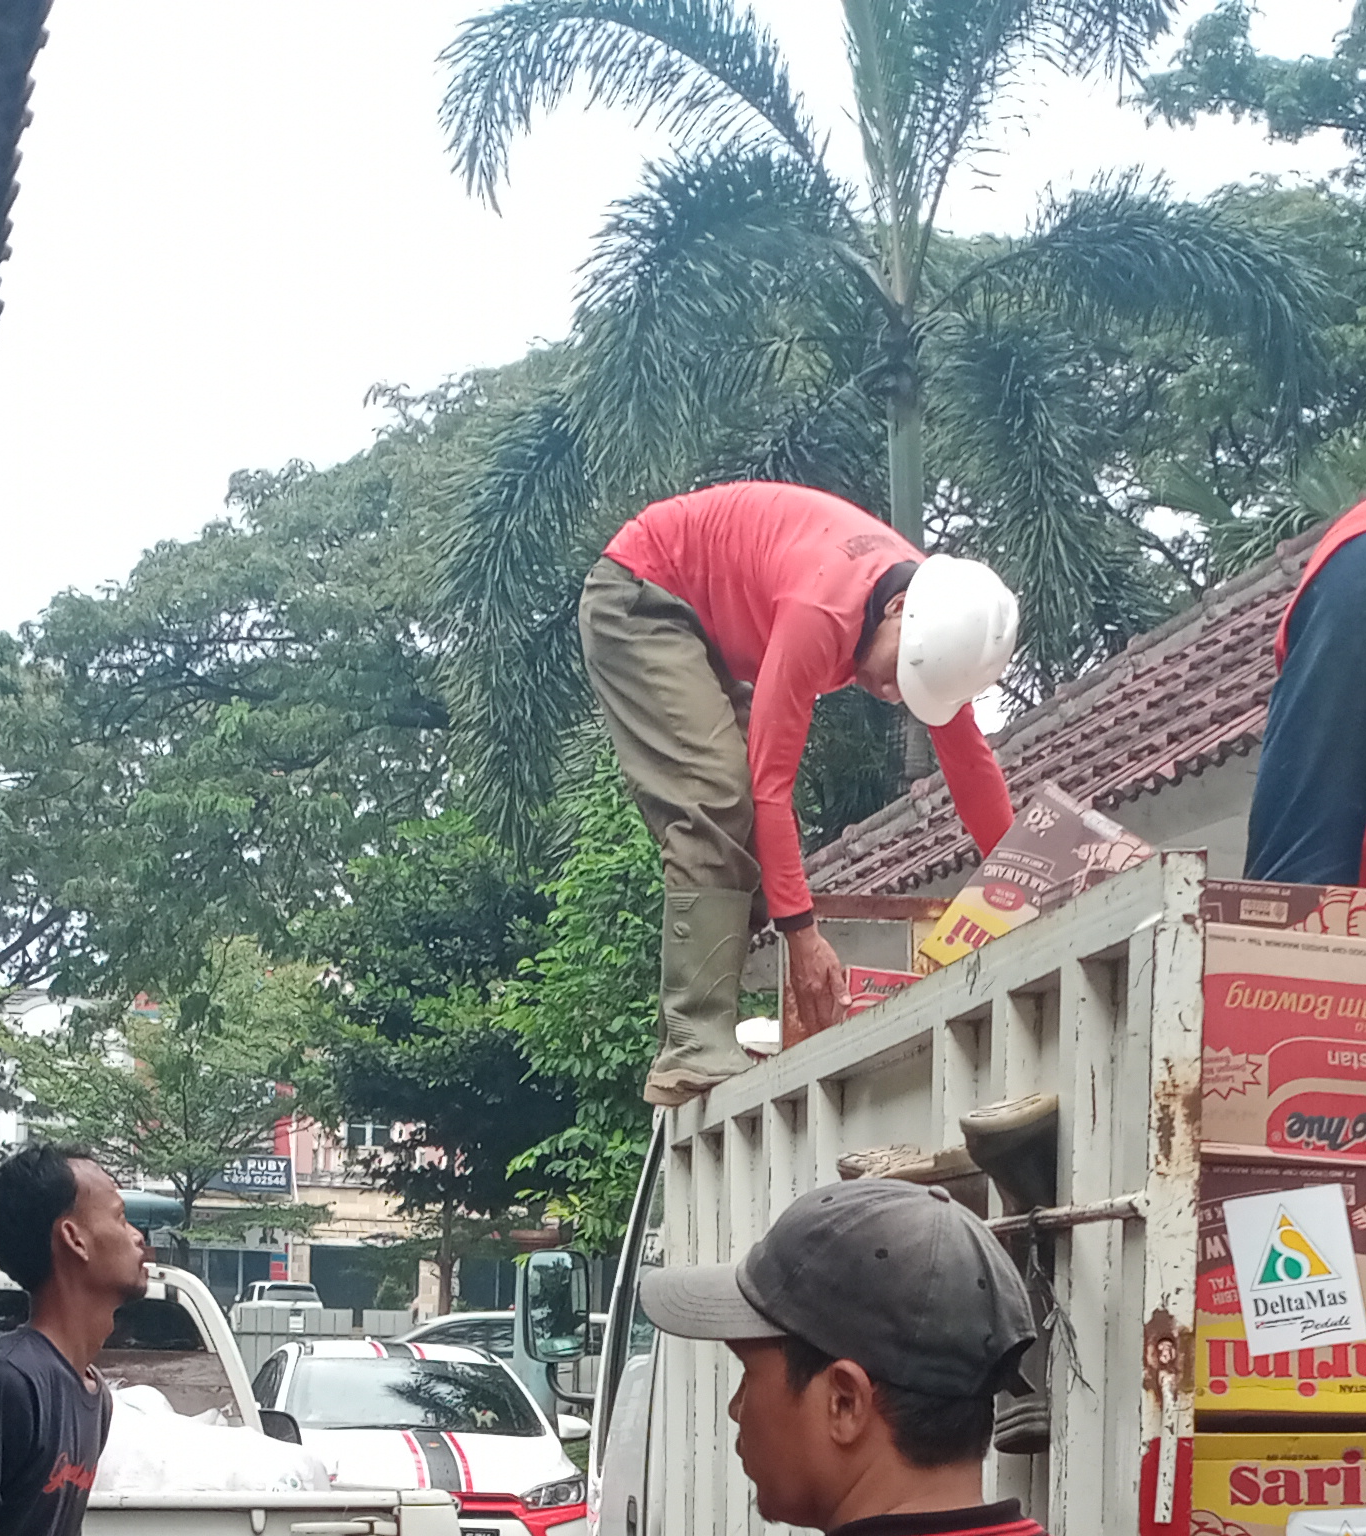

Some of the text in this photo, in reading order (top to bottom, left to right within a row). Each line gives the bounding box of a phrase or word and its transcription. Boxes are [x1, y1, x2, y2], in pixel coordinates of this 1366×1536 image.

[1224, 980, 1334, 1020] Bawang
[247, 1158, 287, 1171] RUBY
[1212, 1292, 1239, 1306] EBIH
[1253, 1287, 1348, 1318] DeltaMas
[1301, 1315, 1352, 1334] Peduli
